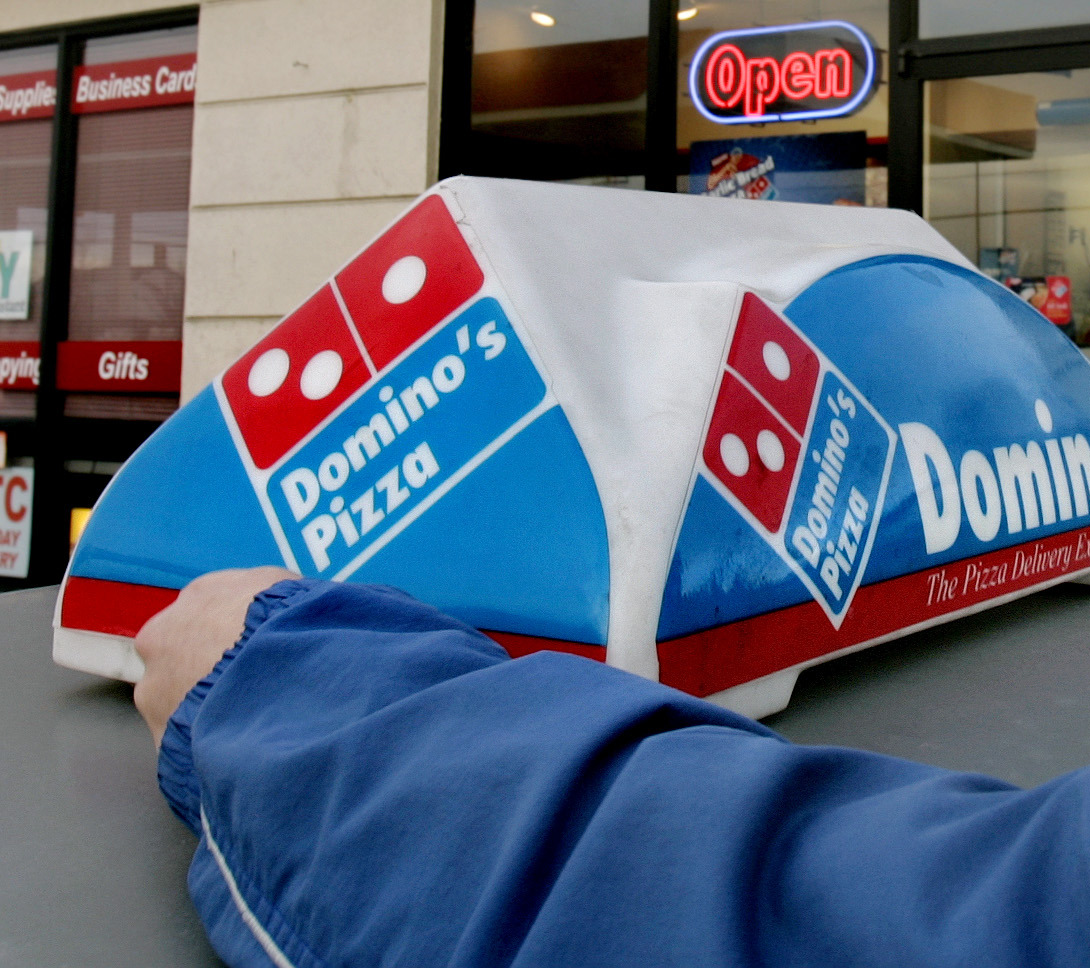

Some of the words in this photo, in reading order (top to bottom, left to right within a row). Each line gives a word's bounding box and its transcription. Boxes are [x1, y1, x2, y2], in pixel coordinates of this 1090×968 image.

[76, 73, 151, 103] Business
[155, 63, 196, 94] Card
[706, 43, 852, 116] Open
[98, 352, 149, 380] Gifts
[280, 321, 507, 522] Domino's
[0, 474, 28, 523] C
[301, 441, 440, 572] Pizza
[792, 389, 856, 569] Domino's
[820, 485, 869, 601] Pizza
[926, 570, 958, 606] The
[962, 561, 1008, 595] Pizza
[1011, 543, 1072, 581] Delivery
